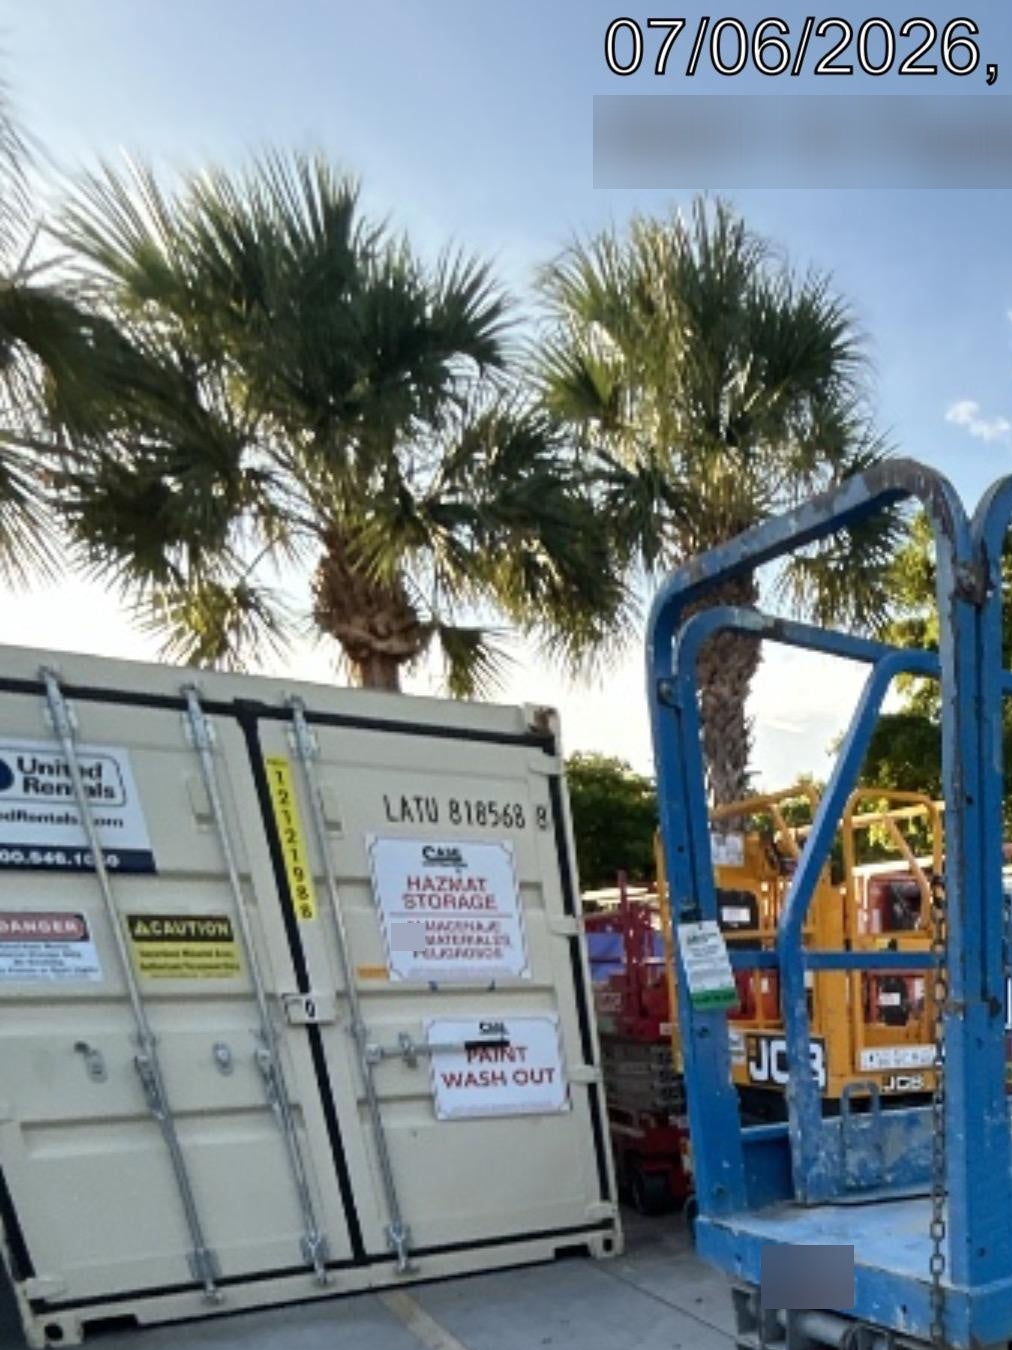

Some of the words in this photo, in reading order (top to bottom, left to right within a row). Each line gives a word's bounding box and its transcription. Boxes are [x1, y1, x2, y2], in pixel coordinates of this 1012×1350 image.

[23, 776, 115, 799] Renals
[383, 794, 439, 823] LATU
[449, 797, 526, 830] 818568
[406, 874, 488, 892] HAZMAT
[402, 893, 499, 910] STORAGE
[153, 920, 229, 936] CAUTION
[466, 1046, 528, 1064] PAINT
[441, 1070, 507, 1089] WASH
[512, 1067, 555, 1086] OUT
[883, 1075, 924, 1090] JCB
